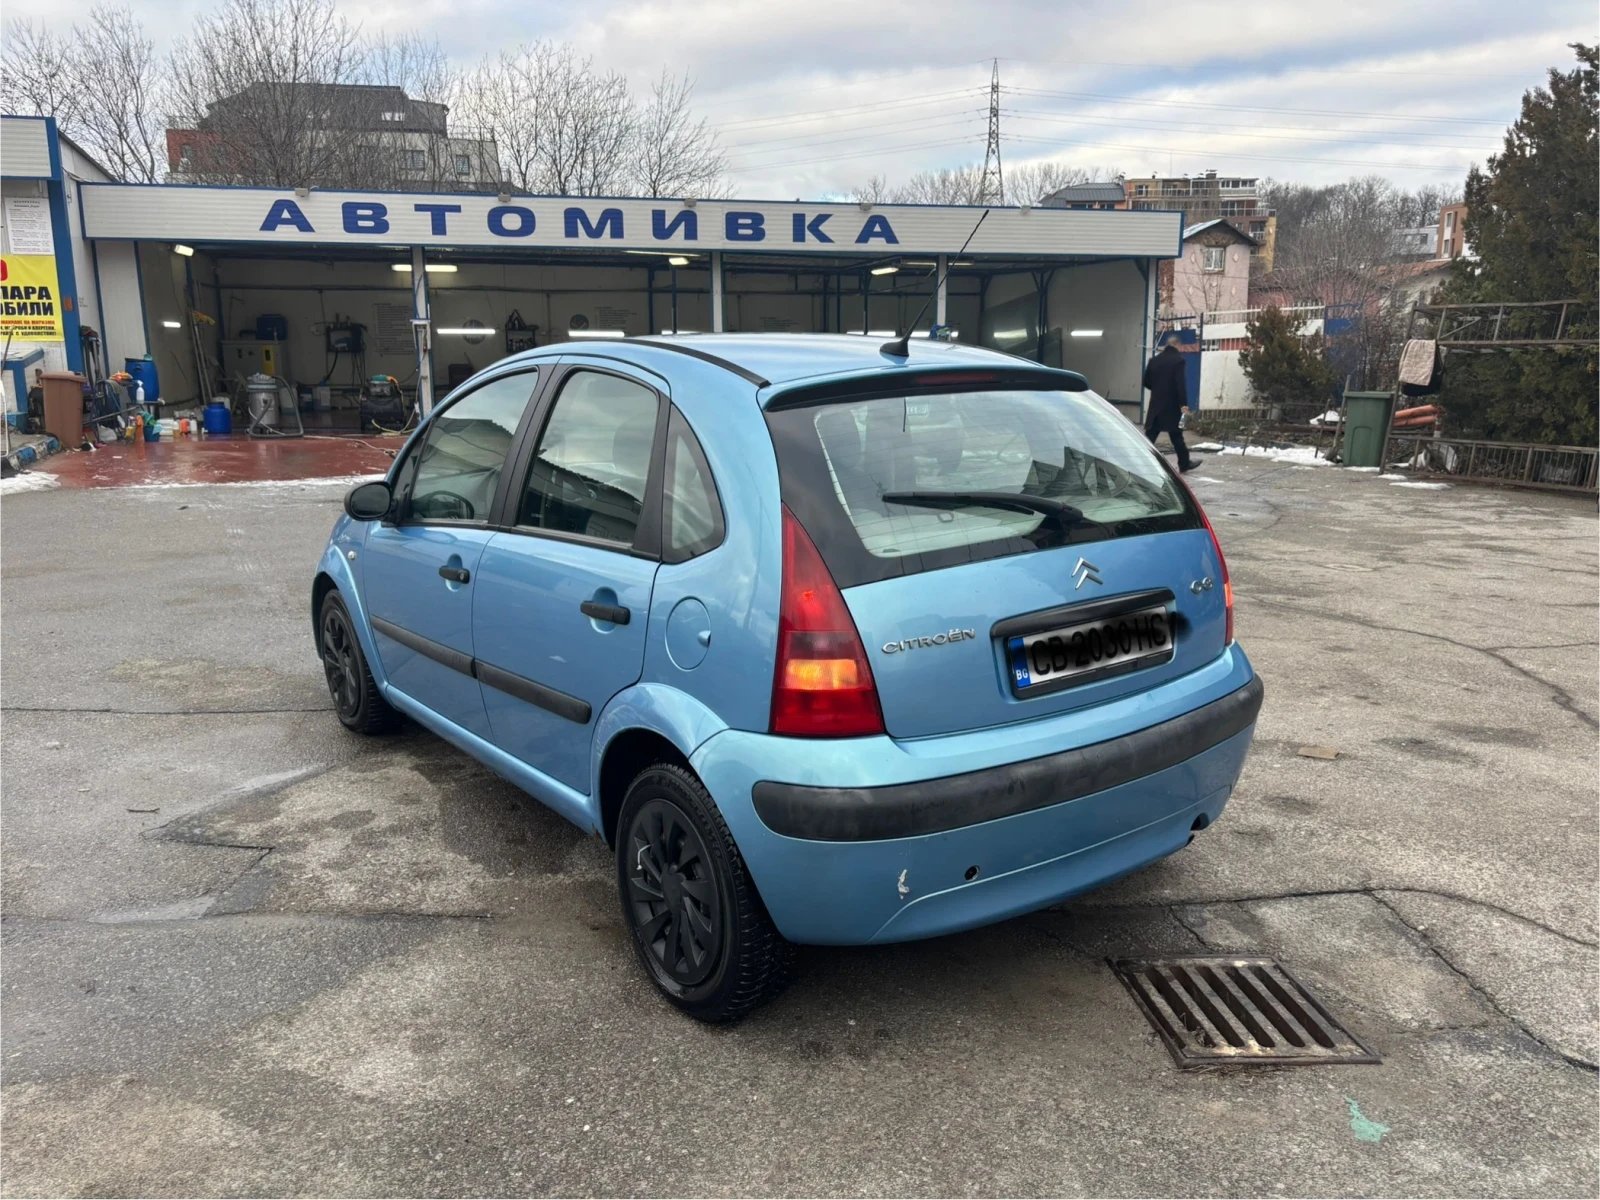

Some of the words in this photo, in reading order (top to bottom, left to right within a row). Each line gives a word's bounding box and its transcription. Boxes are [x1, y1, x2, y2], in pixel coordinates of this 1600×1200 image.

[259, 199, 899, 244] АВТОМИВКА
[0, 302, 54, 316] БИЛИ
[1191, 577, 1213, 594] C3
[882, 628, 975, 654] CITROËN
[1016, 668, 1029, 680] BG
